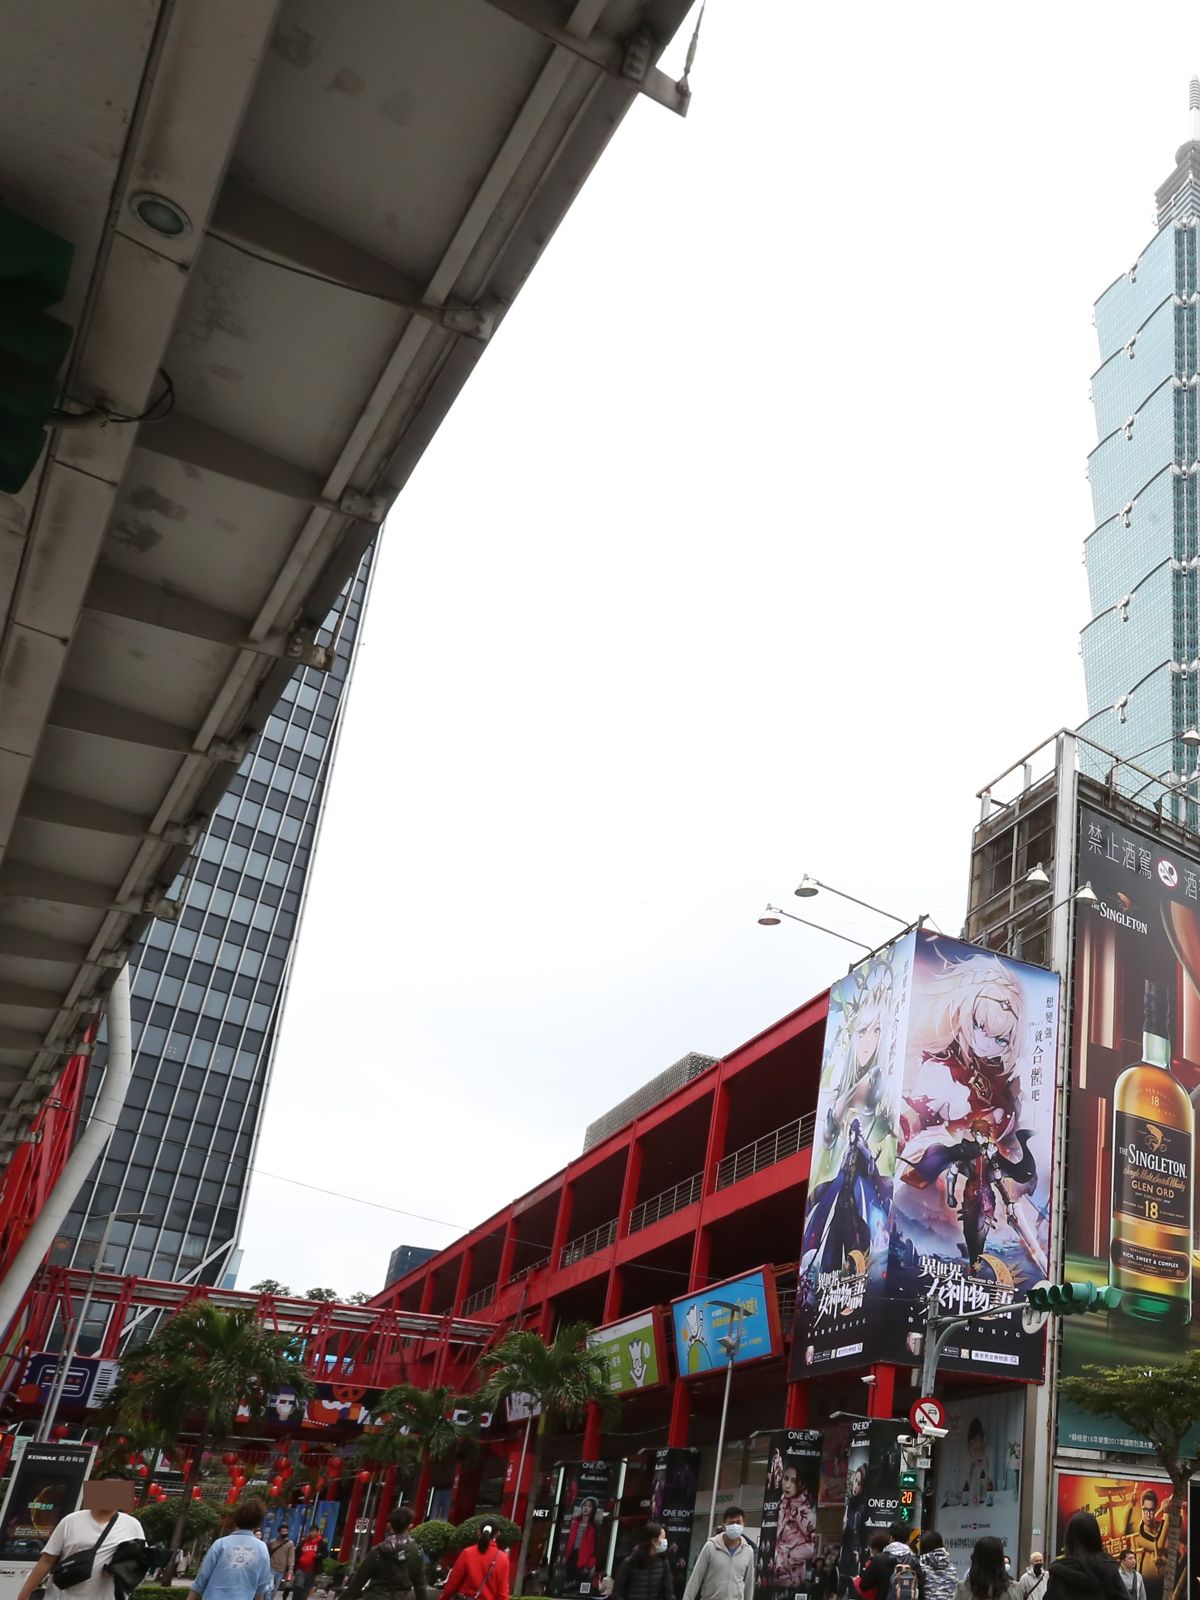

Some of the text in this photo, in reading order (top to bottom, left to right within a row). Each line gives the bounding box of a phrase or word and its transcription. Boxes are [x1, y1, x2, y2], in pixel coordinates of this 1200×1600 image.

[1088, 822, 1152, 880] 禁止酒駕
[1100, 902, 1148, 935] SINGLETON
[1119, 1146, 1128, 1156] THE
[1131, 1180, 1175, 1199] GLEN ORD
[1145, 1200, 1159, 1219] 18
[918, 1255, 963, 1279] 異世界
[1136, 1255, 1152, 1264] SWEET
[1158, 1260, 1179, 1269] COMPLEX
[788, 1431, 804, 1440] ONE
[867, 1499, 899, 1509] ONE BO
[901, 1491, 912, 1504] 20
[533, 1509, 549, 1518] NET
[662, 1509, 677, 1517] ONE
